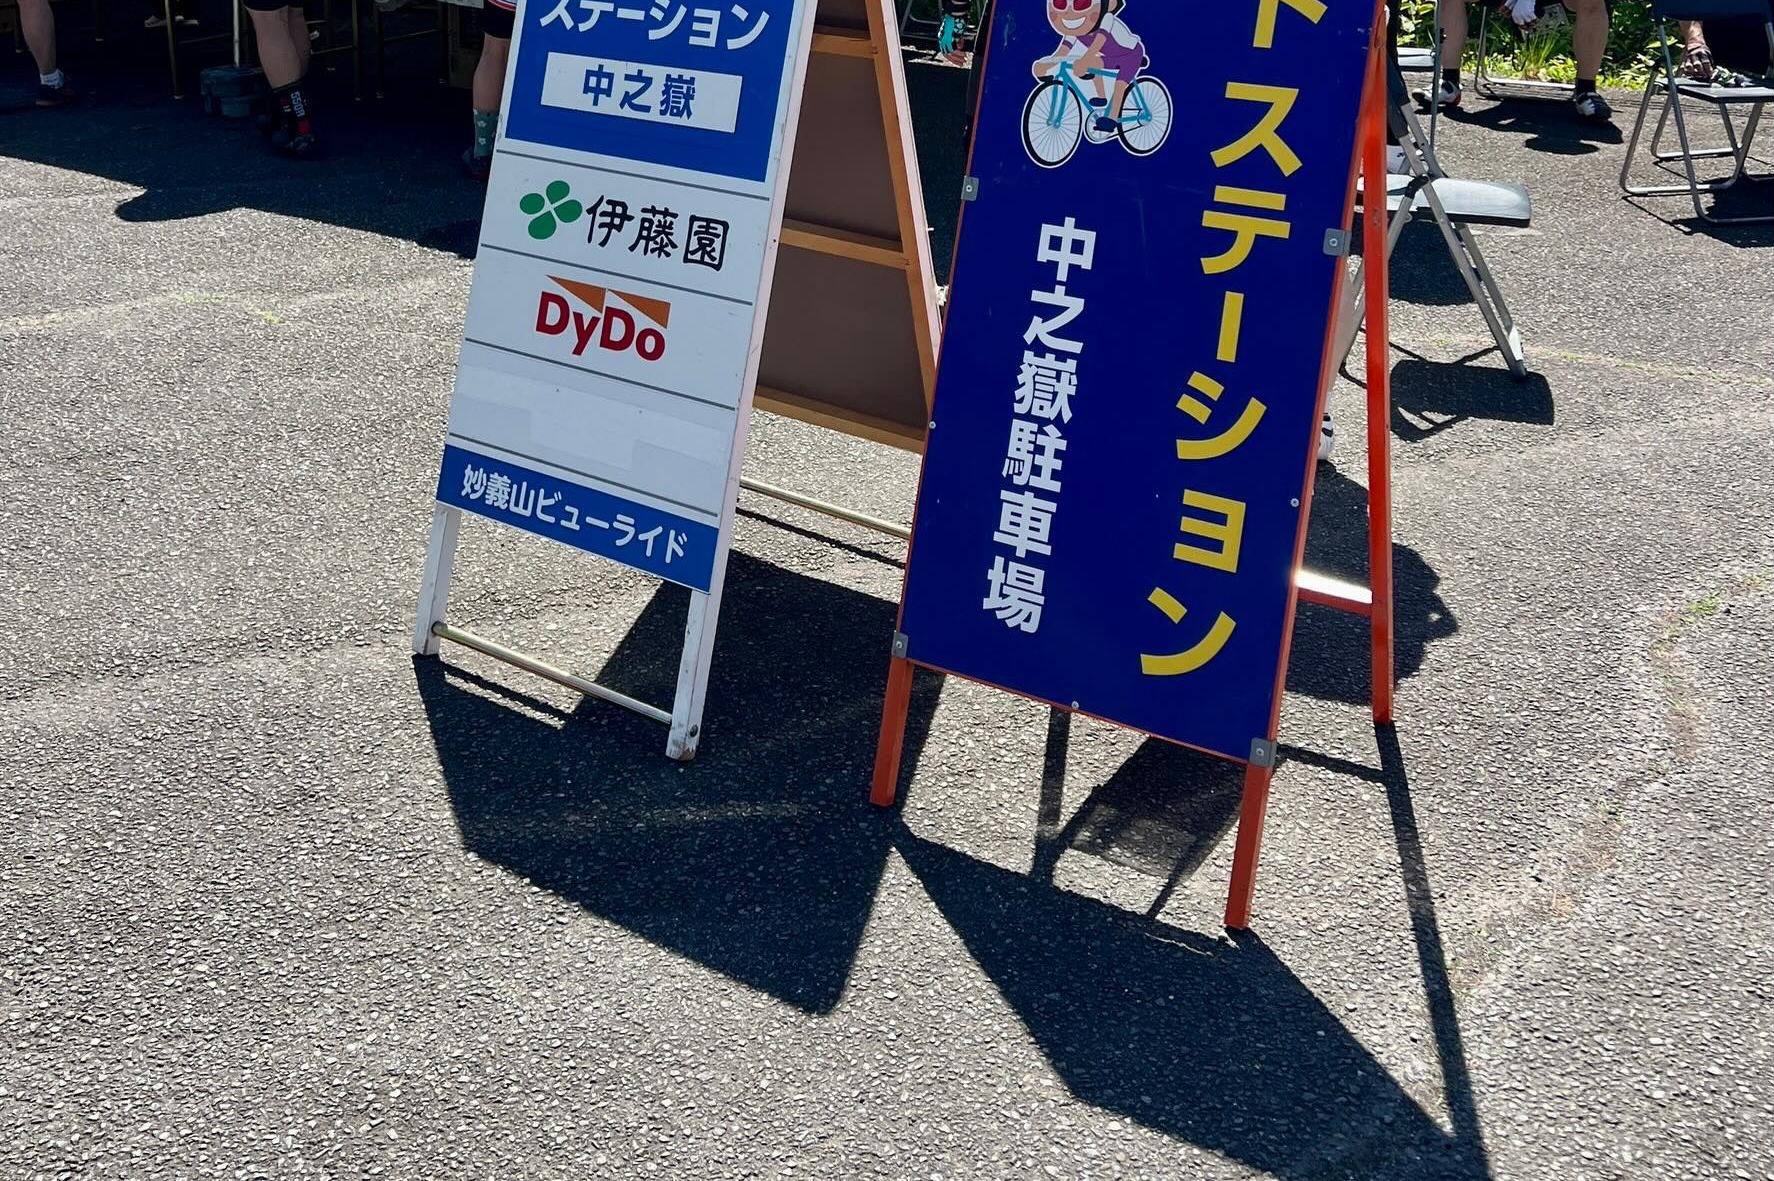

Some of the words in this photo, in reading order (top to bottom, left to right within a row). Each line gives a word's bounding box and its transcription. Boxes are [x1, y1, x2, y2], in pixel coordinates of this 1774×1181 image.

[583, 64, 697, 120] 中之嶽
[585, 194, 730, 272] 伊藤園
[535, 290, 667, 362] DyDo
[982, 216, 1097, 634] 中之嶽駐車場
[461, 464, 688, 564] 妙義山ビューライド
